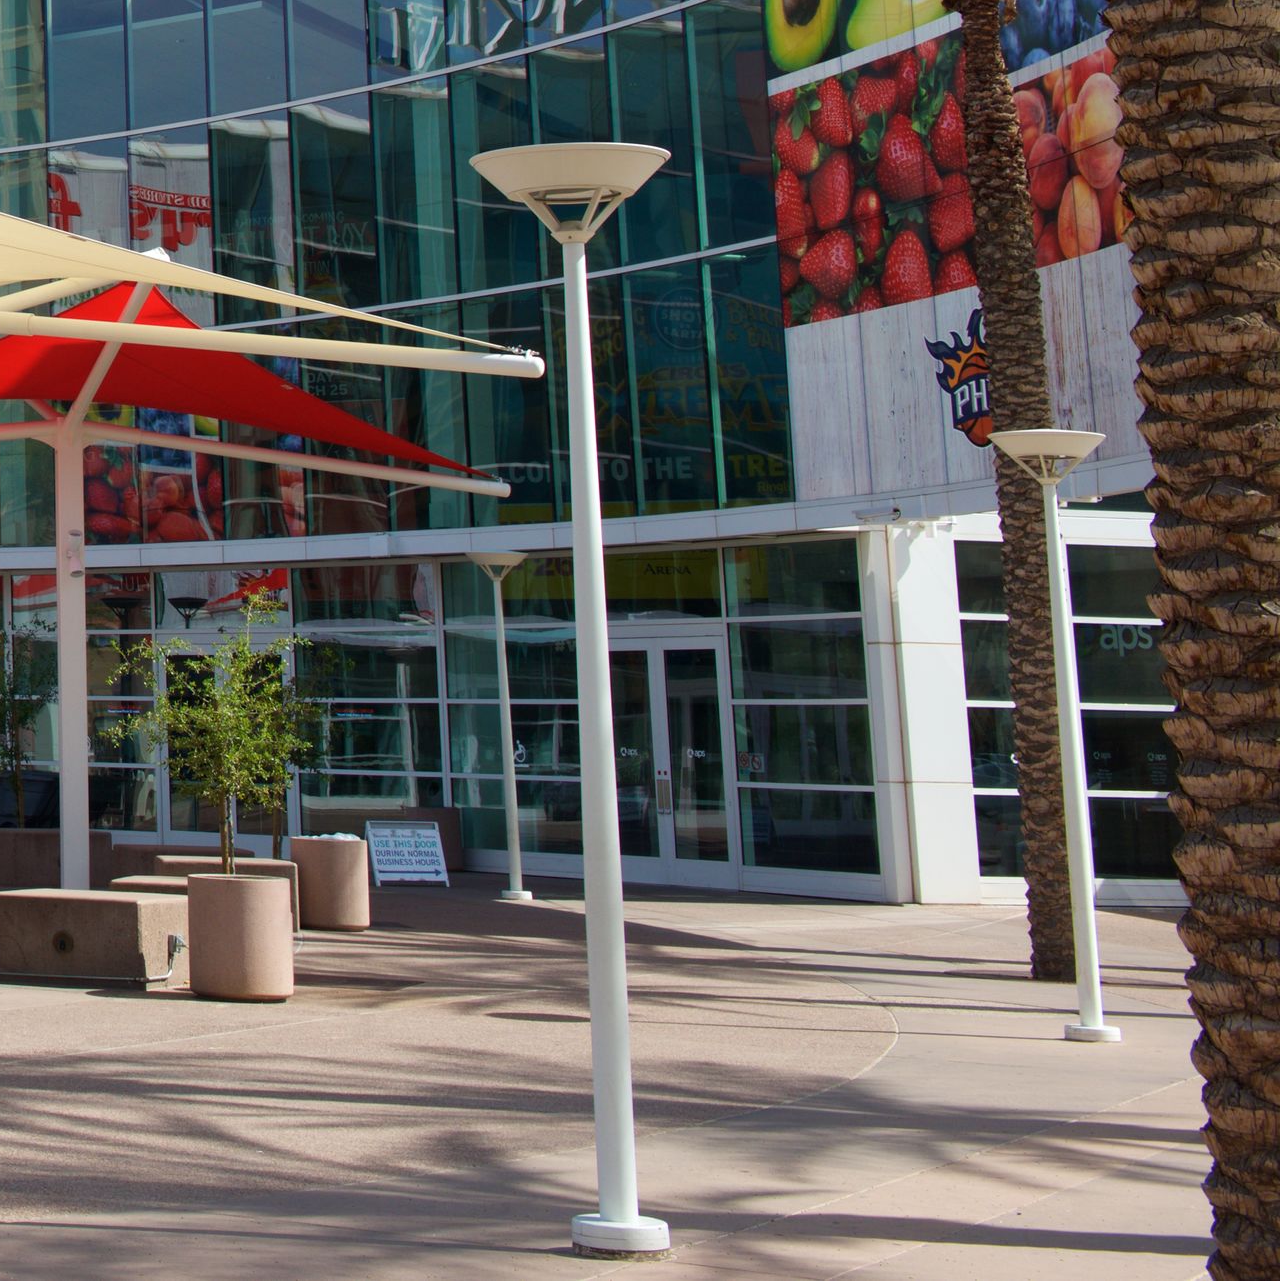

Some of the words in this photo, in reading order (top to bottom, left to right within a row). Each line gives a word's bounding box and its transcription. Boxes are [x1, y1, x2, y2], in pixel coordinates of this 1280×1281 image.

[954, 379, 990, 419] PH
[1099, 624, 1153, 657] aps
[374, 840, 391, 848] USE
[393, 840, 413, 848] THIS
[415, 840, 438, 849] DOOR
[375, 849, 406, 857] DURING
[407, 850, 440, 858] NORMAL
[377, 858, 414, 866] BUSINESS
[415, 858, 441, 866] HOURS
